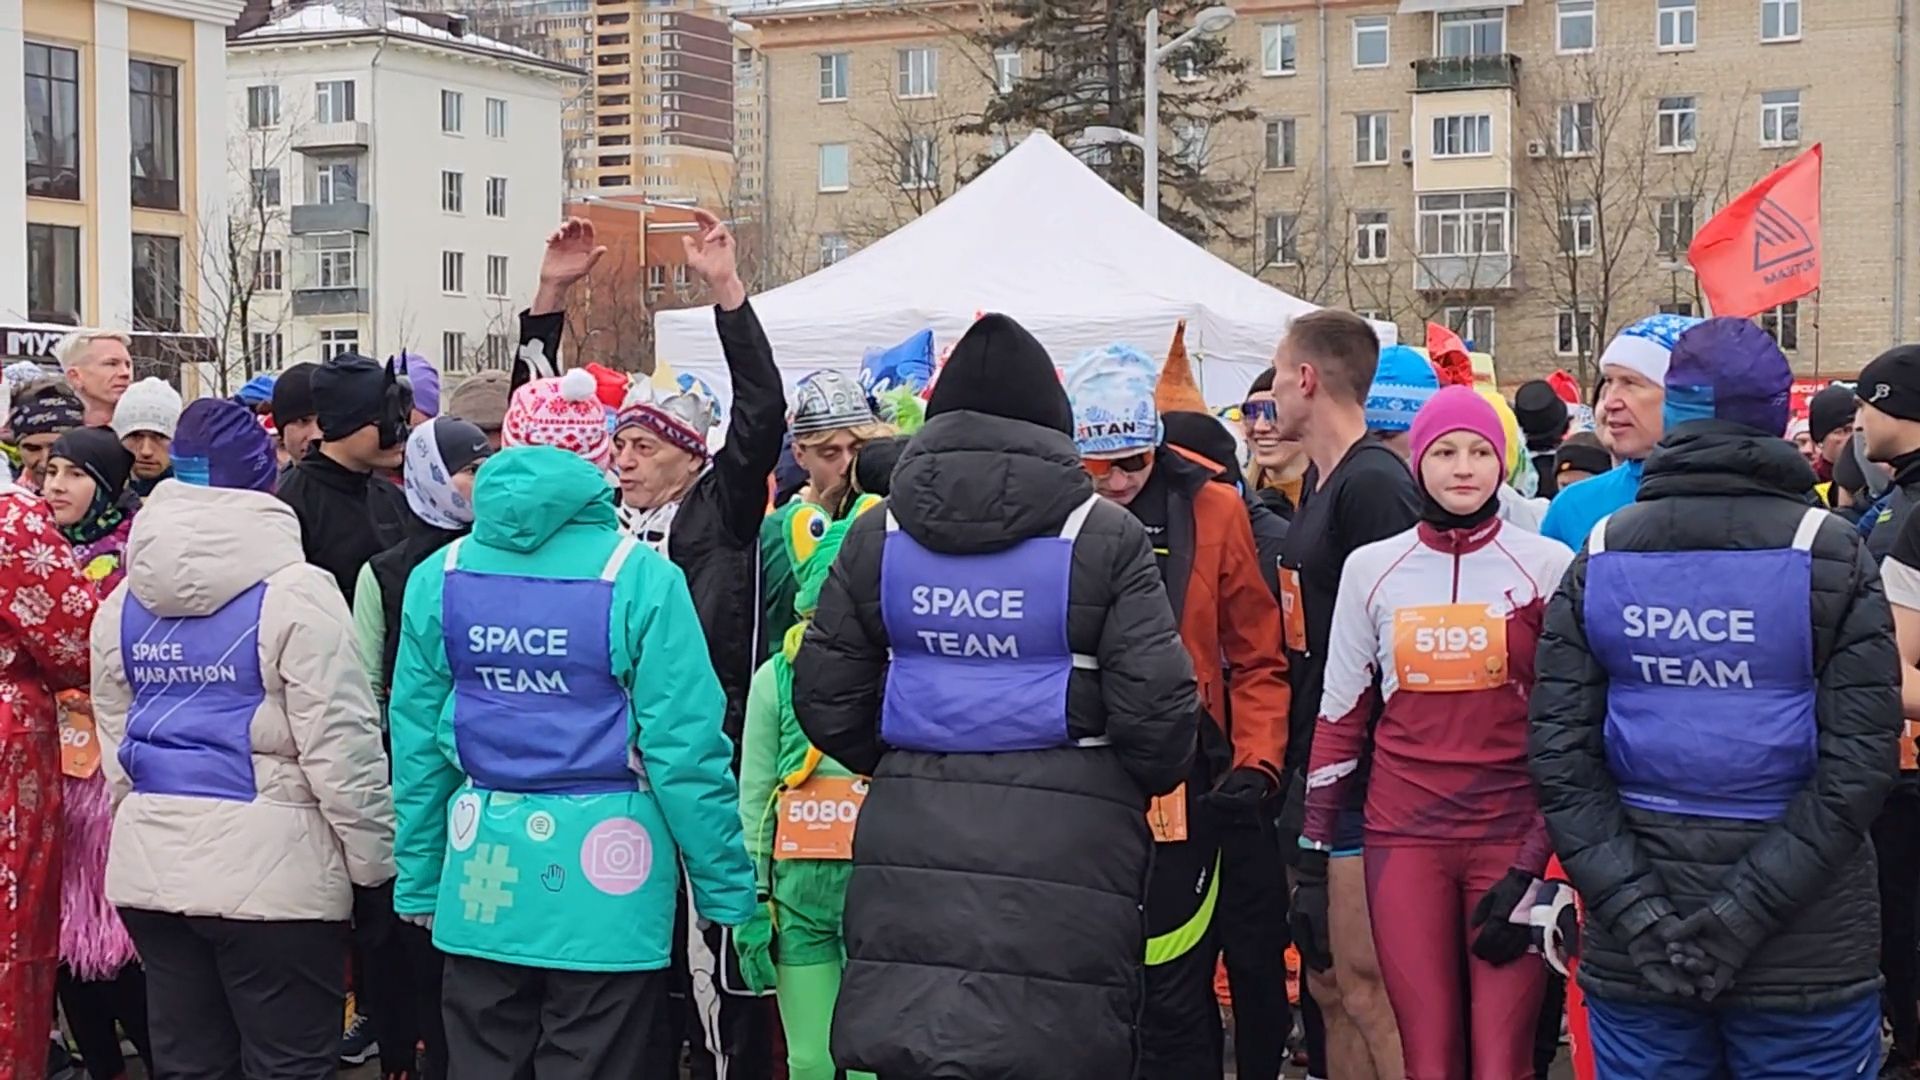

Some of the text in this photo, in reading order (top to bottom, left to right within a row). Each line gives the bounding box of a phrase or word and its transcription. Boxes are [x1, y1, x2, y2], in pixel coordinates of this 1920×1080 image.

[911, 585, 1024, 618] SPACE
[1622, 604, 1755, 642] SPACE
[131, 643, 183, 661] SPACE
[468, 625, 569, 655] SPACE
[917, 630, 1019, 658] TEAM
[1415, 626, 1488, 652] 5193
[133, 665, 236, 683] MARATHON
[475, 665, 570, 694] TEAM
[1632, 654, 1753, 688] TEAM
[788, 799, 858, 823] 5080
